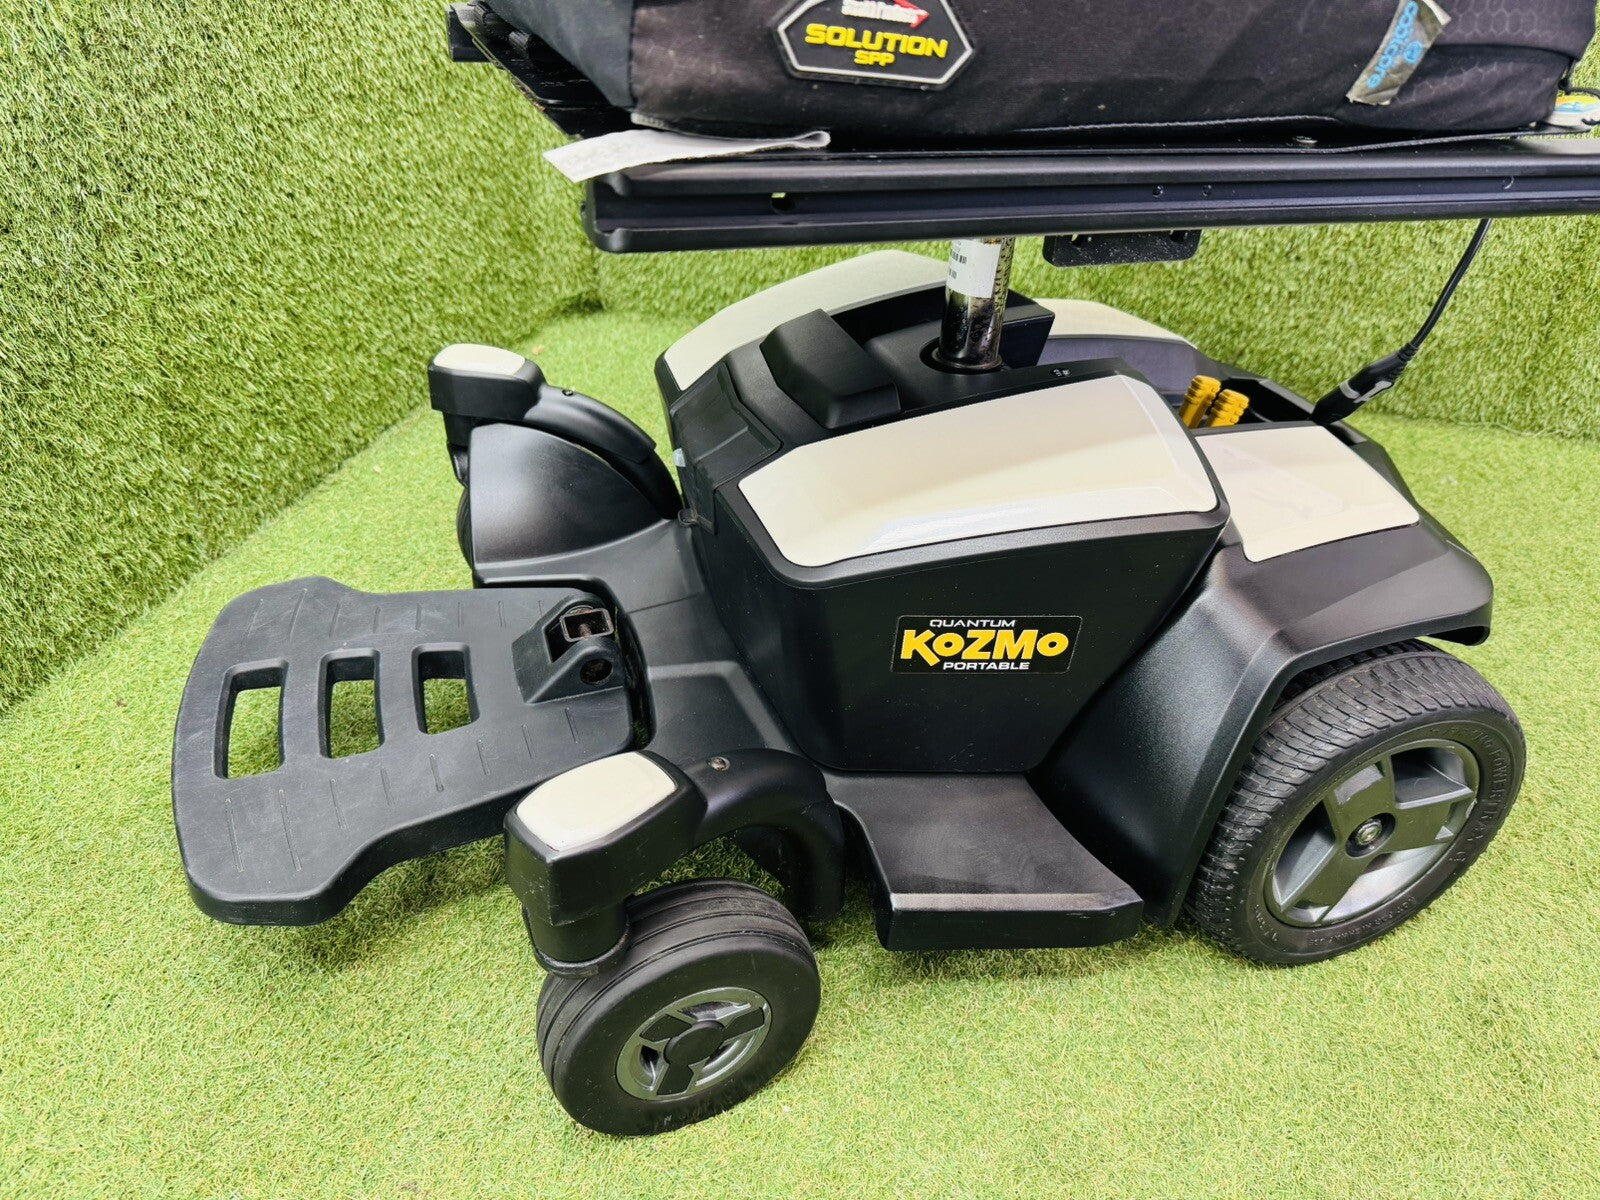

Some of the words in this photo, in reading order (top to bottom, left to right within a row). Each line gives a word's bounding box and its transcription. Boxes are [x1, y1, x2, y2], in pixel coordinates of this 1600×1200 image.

[805, 23, 948, 58] SOLUTION
[854, 50, 895, 66] SPP
[929, 619, 1017, 628] QUANTUM
[943, 661, 1030, 670] PORTABLE
